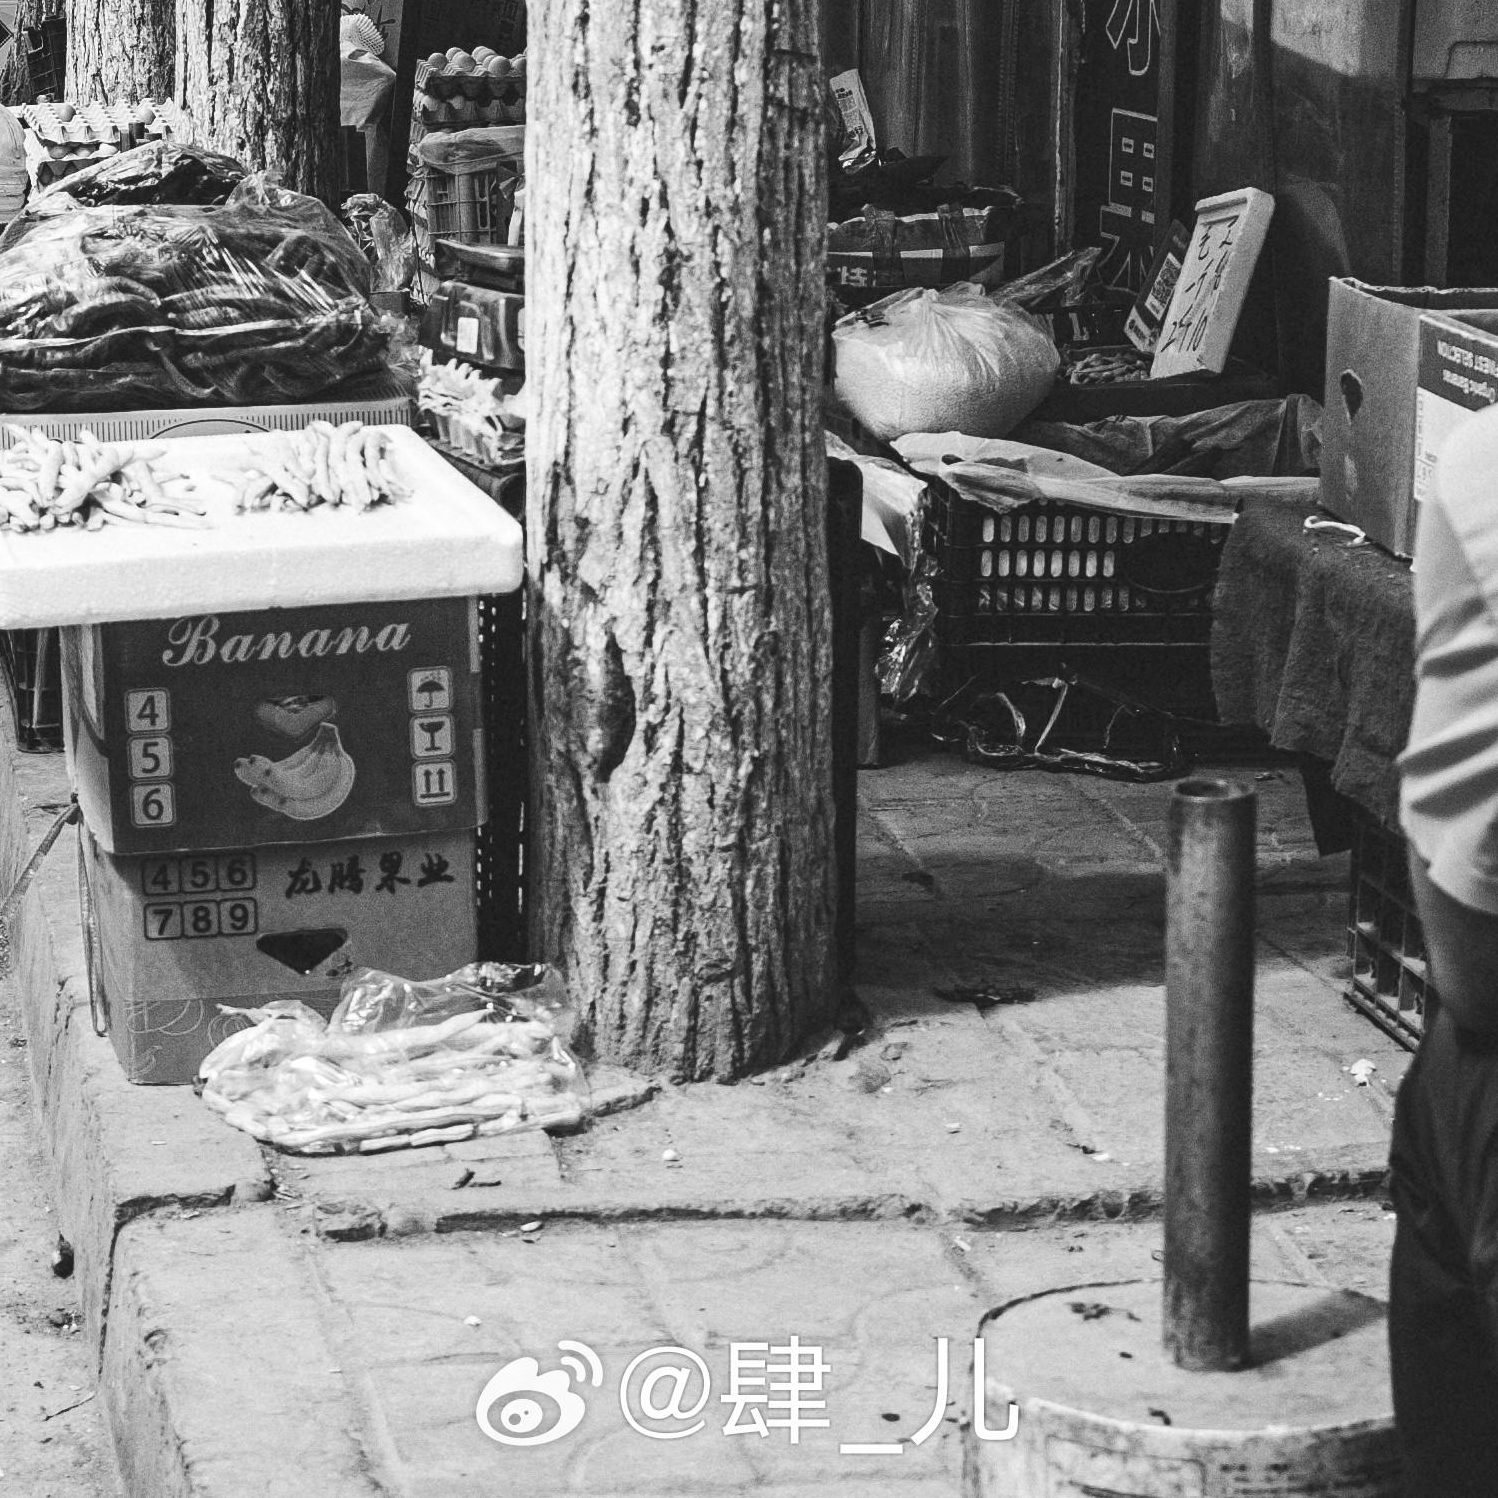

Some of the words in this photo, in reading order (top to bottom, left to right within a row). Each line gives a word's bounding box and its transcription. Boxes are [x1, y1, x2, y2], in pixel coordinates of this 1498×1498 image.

[161, 613, 413, 668] Banana
[137, 695, 160, 723] 4
[141, 742, 161, 774] 5
[142, 790, 164, 822] 6
